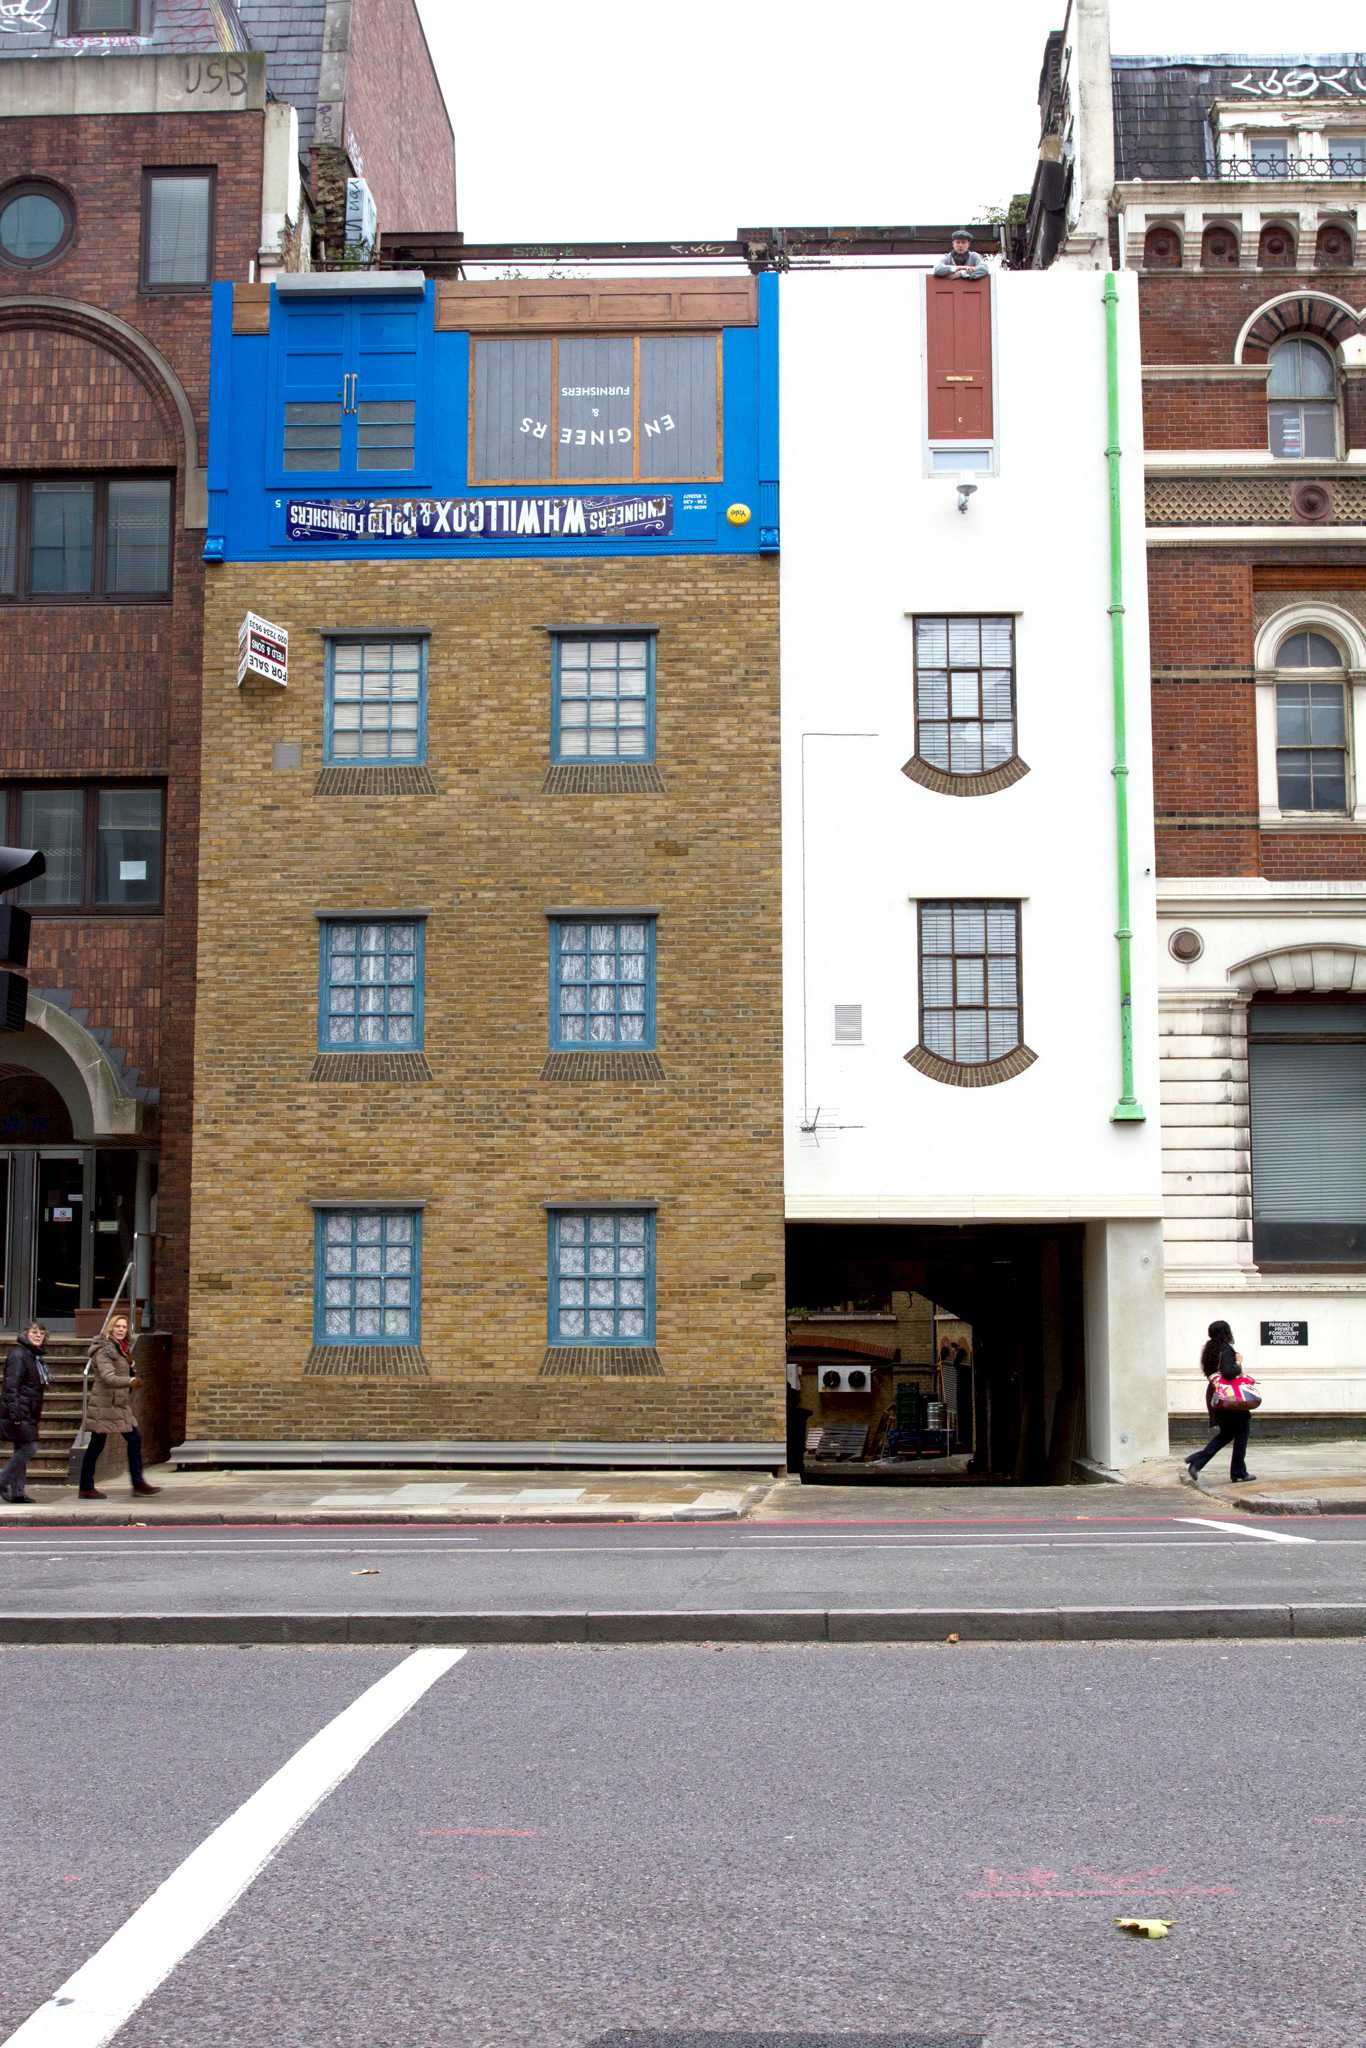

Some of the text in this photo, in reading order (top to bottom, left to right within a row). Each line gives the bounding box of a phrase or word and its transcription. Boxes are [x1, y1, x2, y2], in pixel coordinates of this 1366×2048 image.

[185, 54, 248, 96] USB
[561, 386, 630, 397] FURNISHERS
[591, 408, 600, 417] &
[275, 500, 282, 508] 5
[590, 498, 667, 530] ENGINEERS
[290, 505, 365, 534] FURNISHERS
[419, 502, 438, 527] &
[251, 639, 266, 654] SONS
[278, 634, 288, 645] 020
[249, 655, 288, 681] FOR SALE
